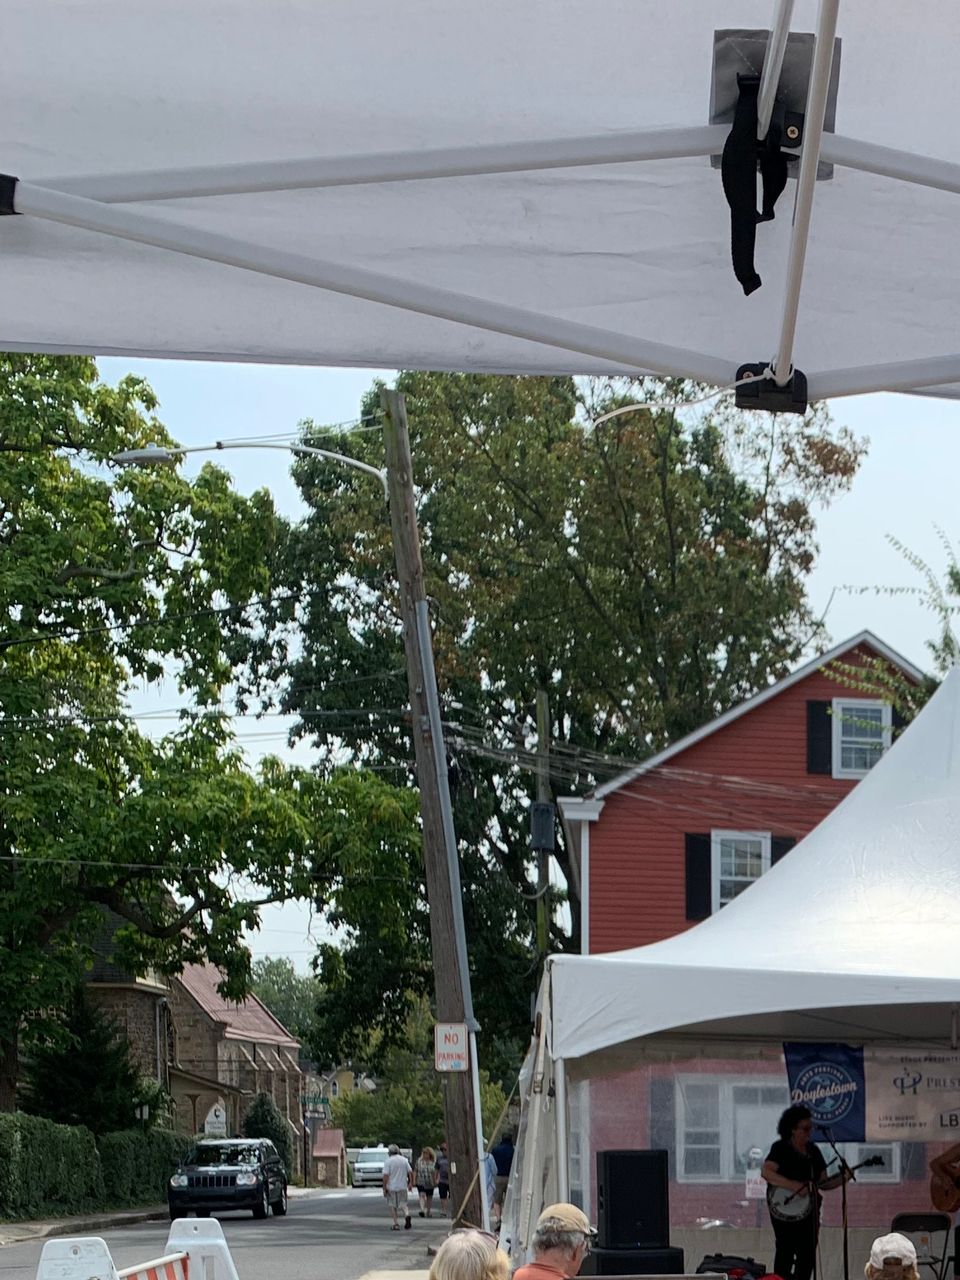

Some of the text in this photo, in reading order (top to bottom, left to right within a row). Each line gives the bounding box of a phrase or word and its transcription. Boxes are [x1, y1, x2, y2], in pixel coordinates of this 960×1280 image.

[444, 1032, 459, 1046] NO
[438, 1052, 465, 1062] PARKING
[791, 1081, 858, 1104] Doylestown
